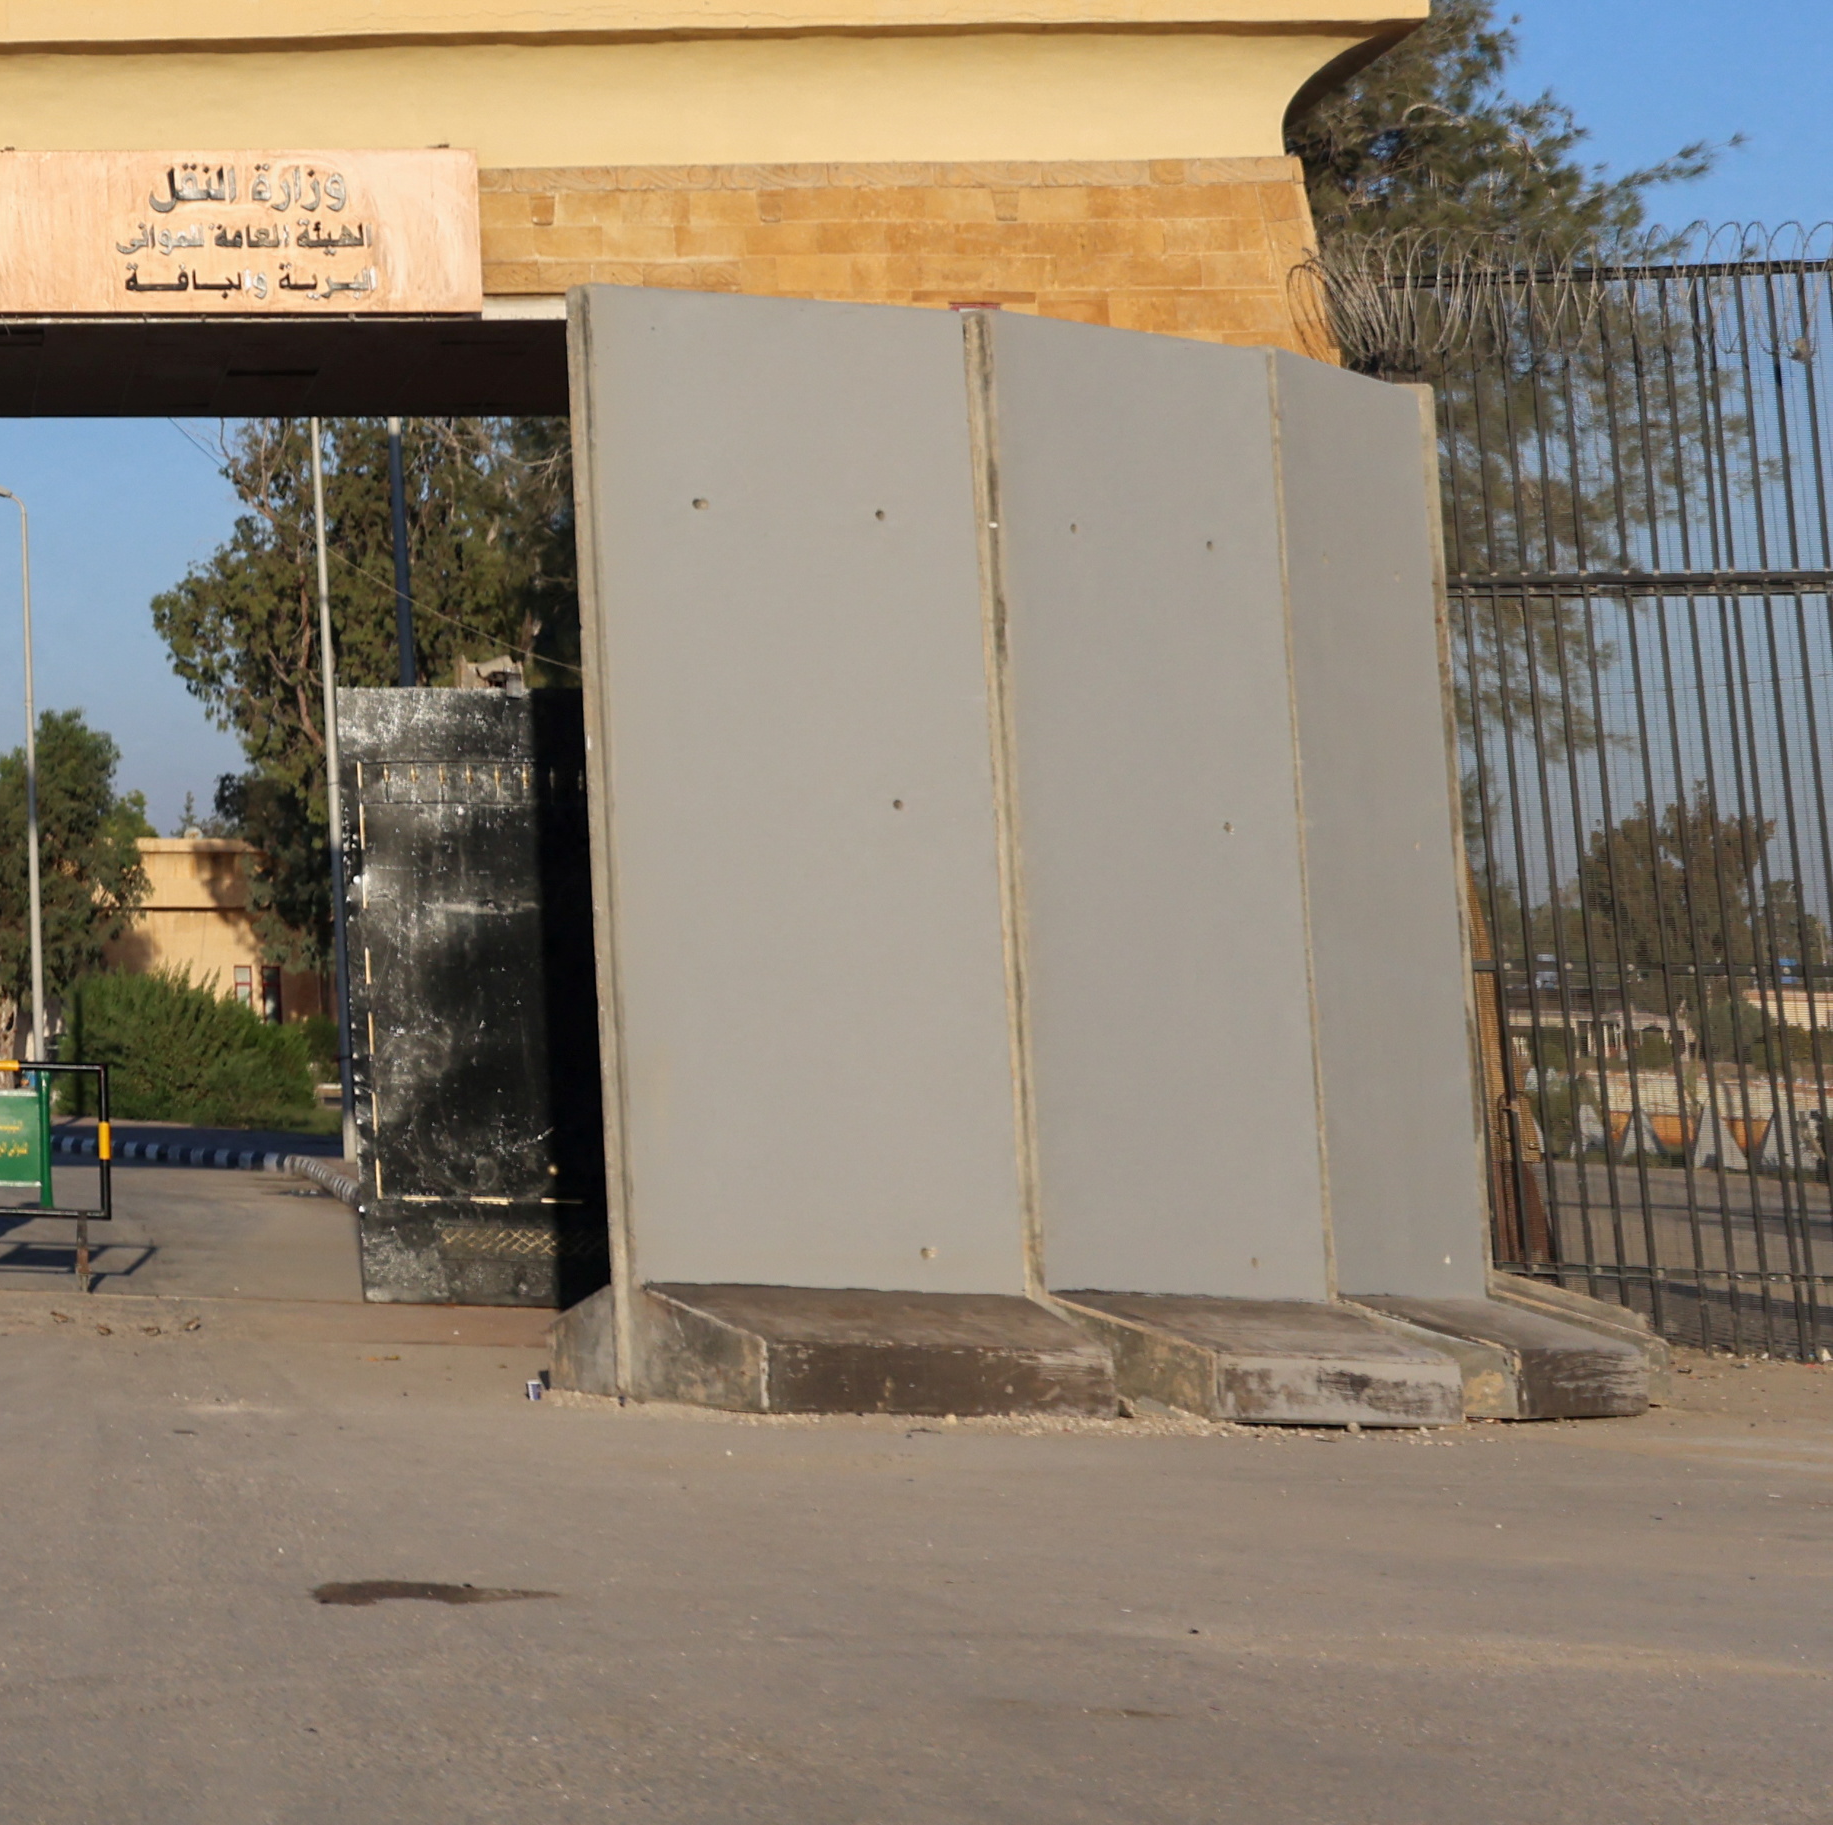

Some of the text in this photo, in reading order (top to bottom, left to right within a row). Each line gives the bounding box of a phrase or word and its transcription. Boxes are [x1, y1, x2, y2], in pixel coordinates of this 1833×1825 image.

[148, 162, 347, 214] وزارة النقل
[208, 222, 289, 250] العامة
[296, 218, 373, 257] الهيئة
[278, 261, 378, 300] البرية
